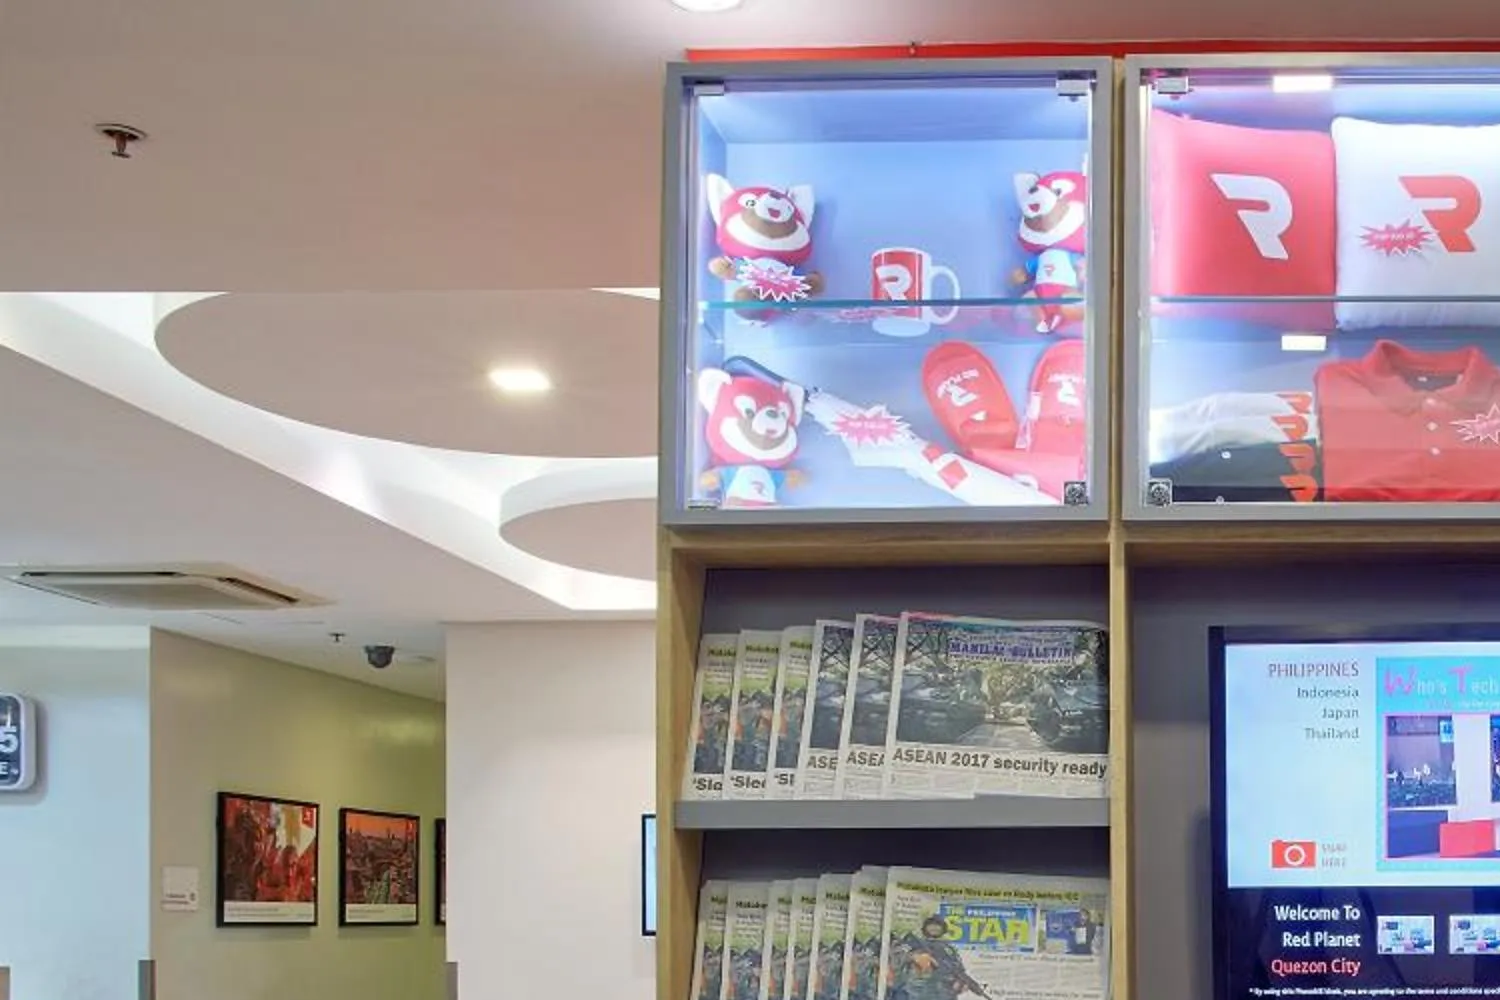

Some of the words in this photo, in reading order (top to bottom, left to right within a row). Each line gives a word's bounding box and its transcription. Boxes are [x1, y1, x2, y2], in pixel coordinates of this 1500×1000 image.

[1268, 663, 1360, 677] PHILIPPINES
[1384, 665, 1447, 697] Who's
[1449, 666, 1499, 695] Tech
[1296, 686, 1360, 698] Indonesia
[1322, 707, 1360, 721] Japan
[1304, 727, 1360, 740] Thailand
[892, 748, 947, 765] ASEAN
[951, 752, 991, 768] 2017
[993, 757, 1058, 776] security
[1062, 762, 1108, 778] ready
[1274, 904, 1340, 921] Welcome
[1343, 904, 1361, 921] To
[946, 915, 1029, 945] STAR
[1283, 931, 1310, 947] Red
[1314, 931, 1361, 947] Planet
[1271, 959, 1327, 977] Quezon
[1331, 957, 1361, 977] City
